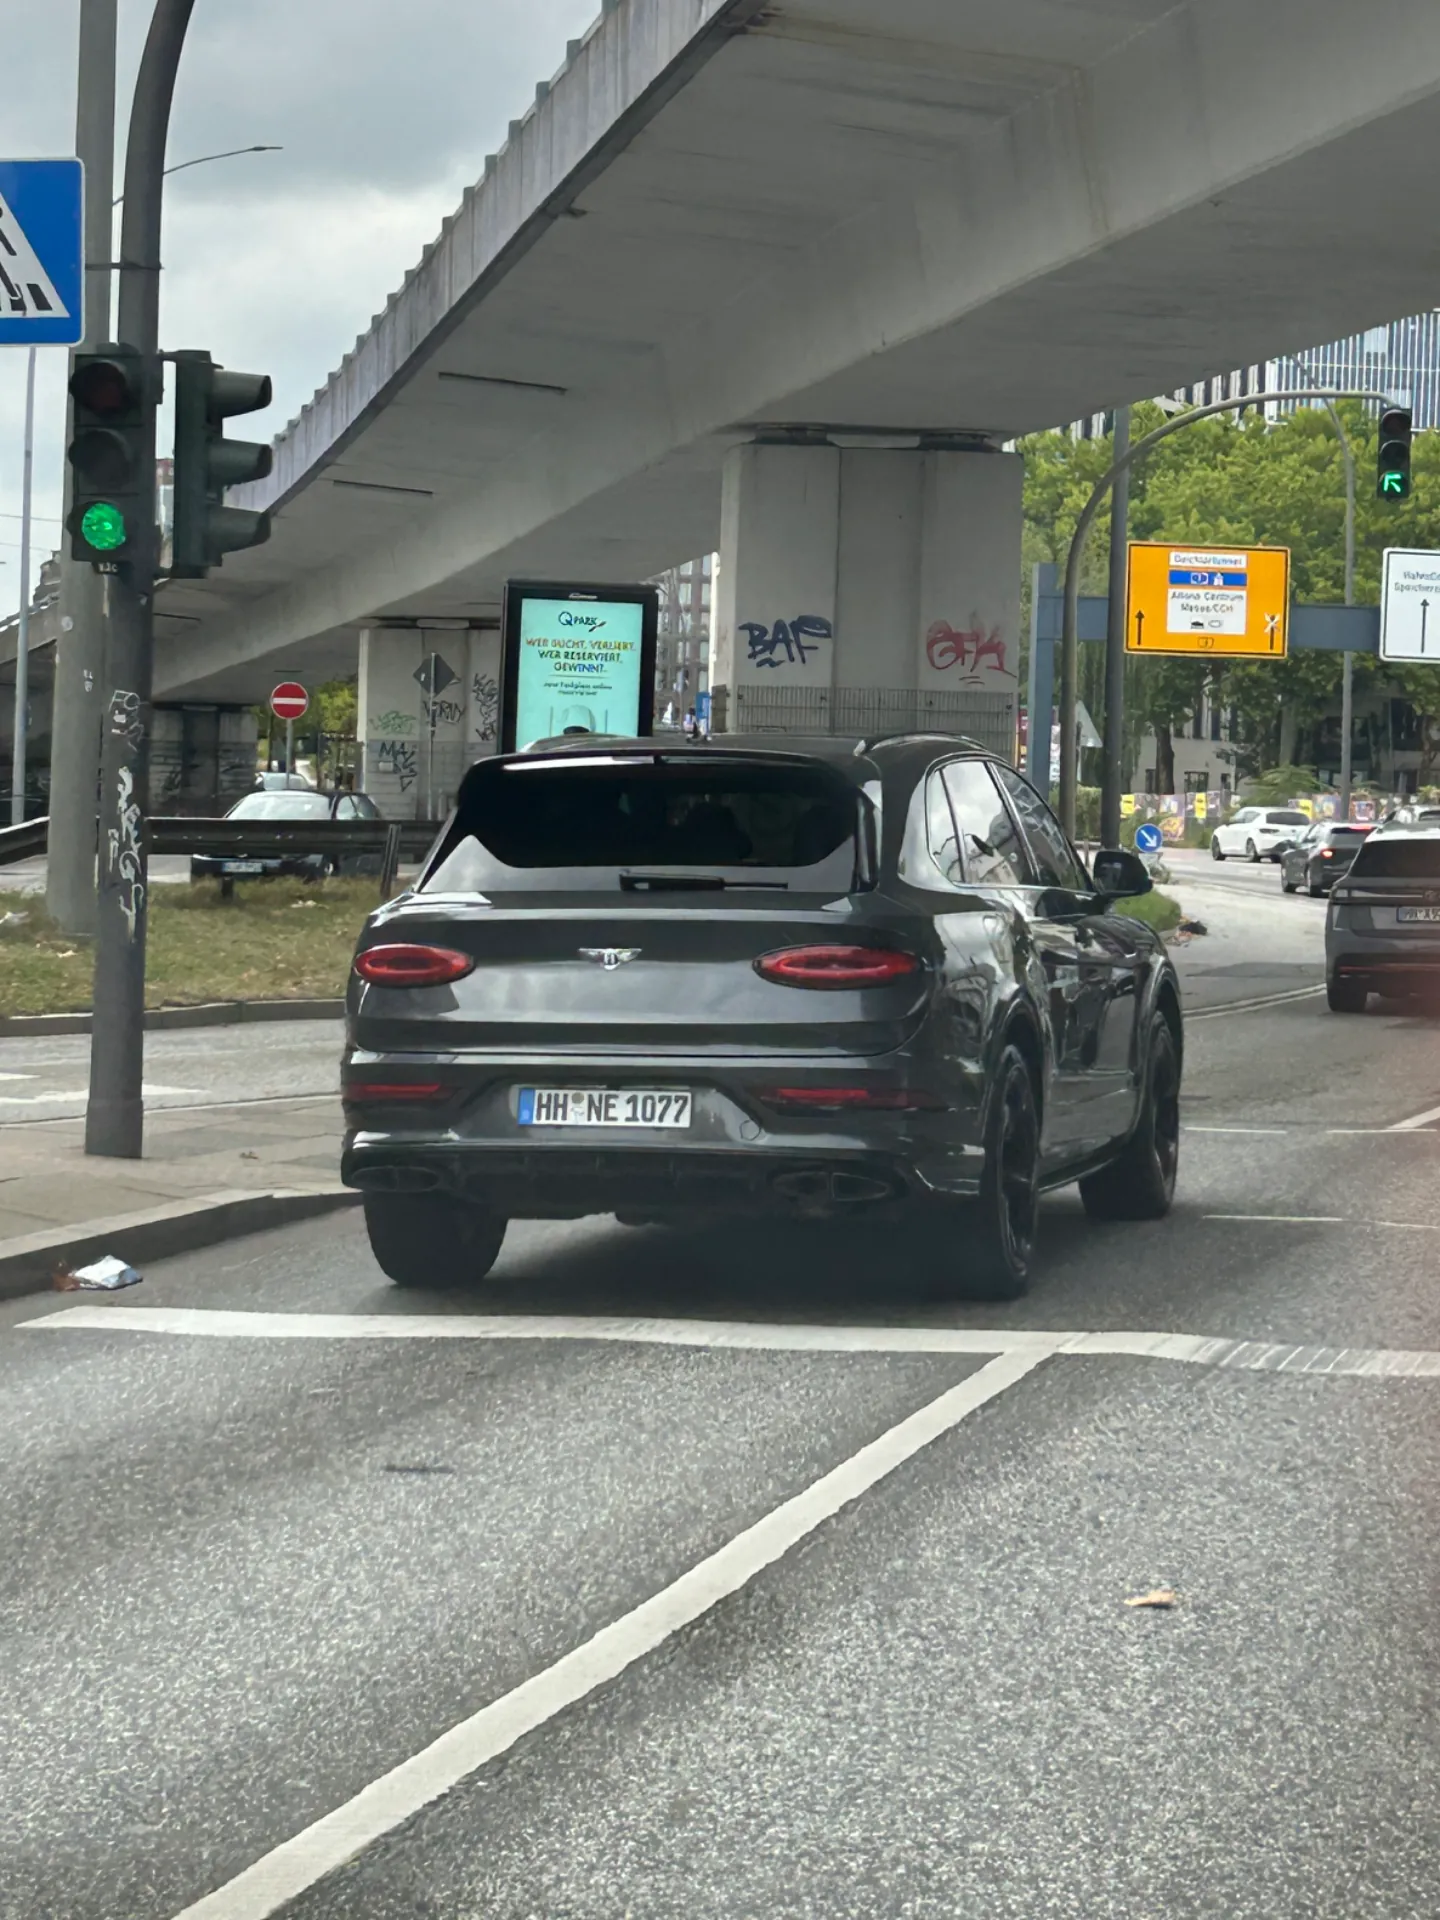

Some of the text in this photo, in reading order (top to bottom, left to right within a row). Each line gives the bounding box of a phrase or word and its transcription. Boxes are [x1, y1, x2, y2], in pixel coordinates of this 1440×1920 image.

[526, 637, 549, 648] WER
[538, 649, 561, 660] WER
[536, 1092, 690, 1124] HH NE 1077
